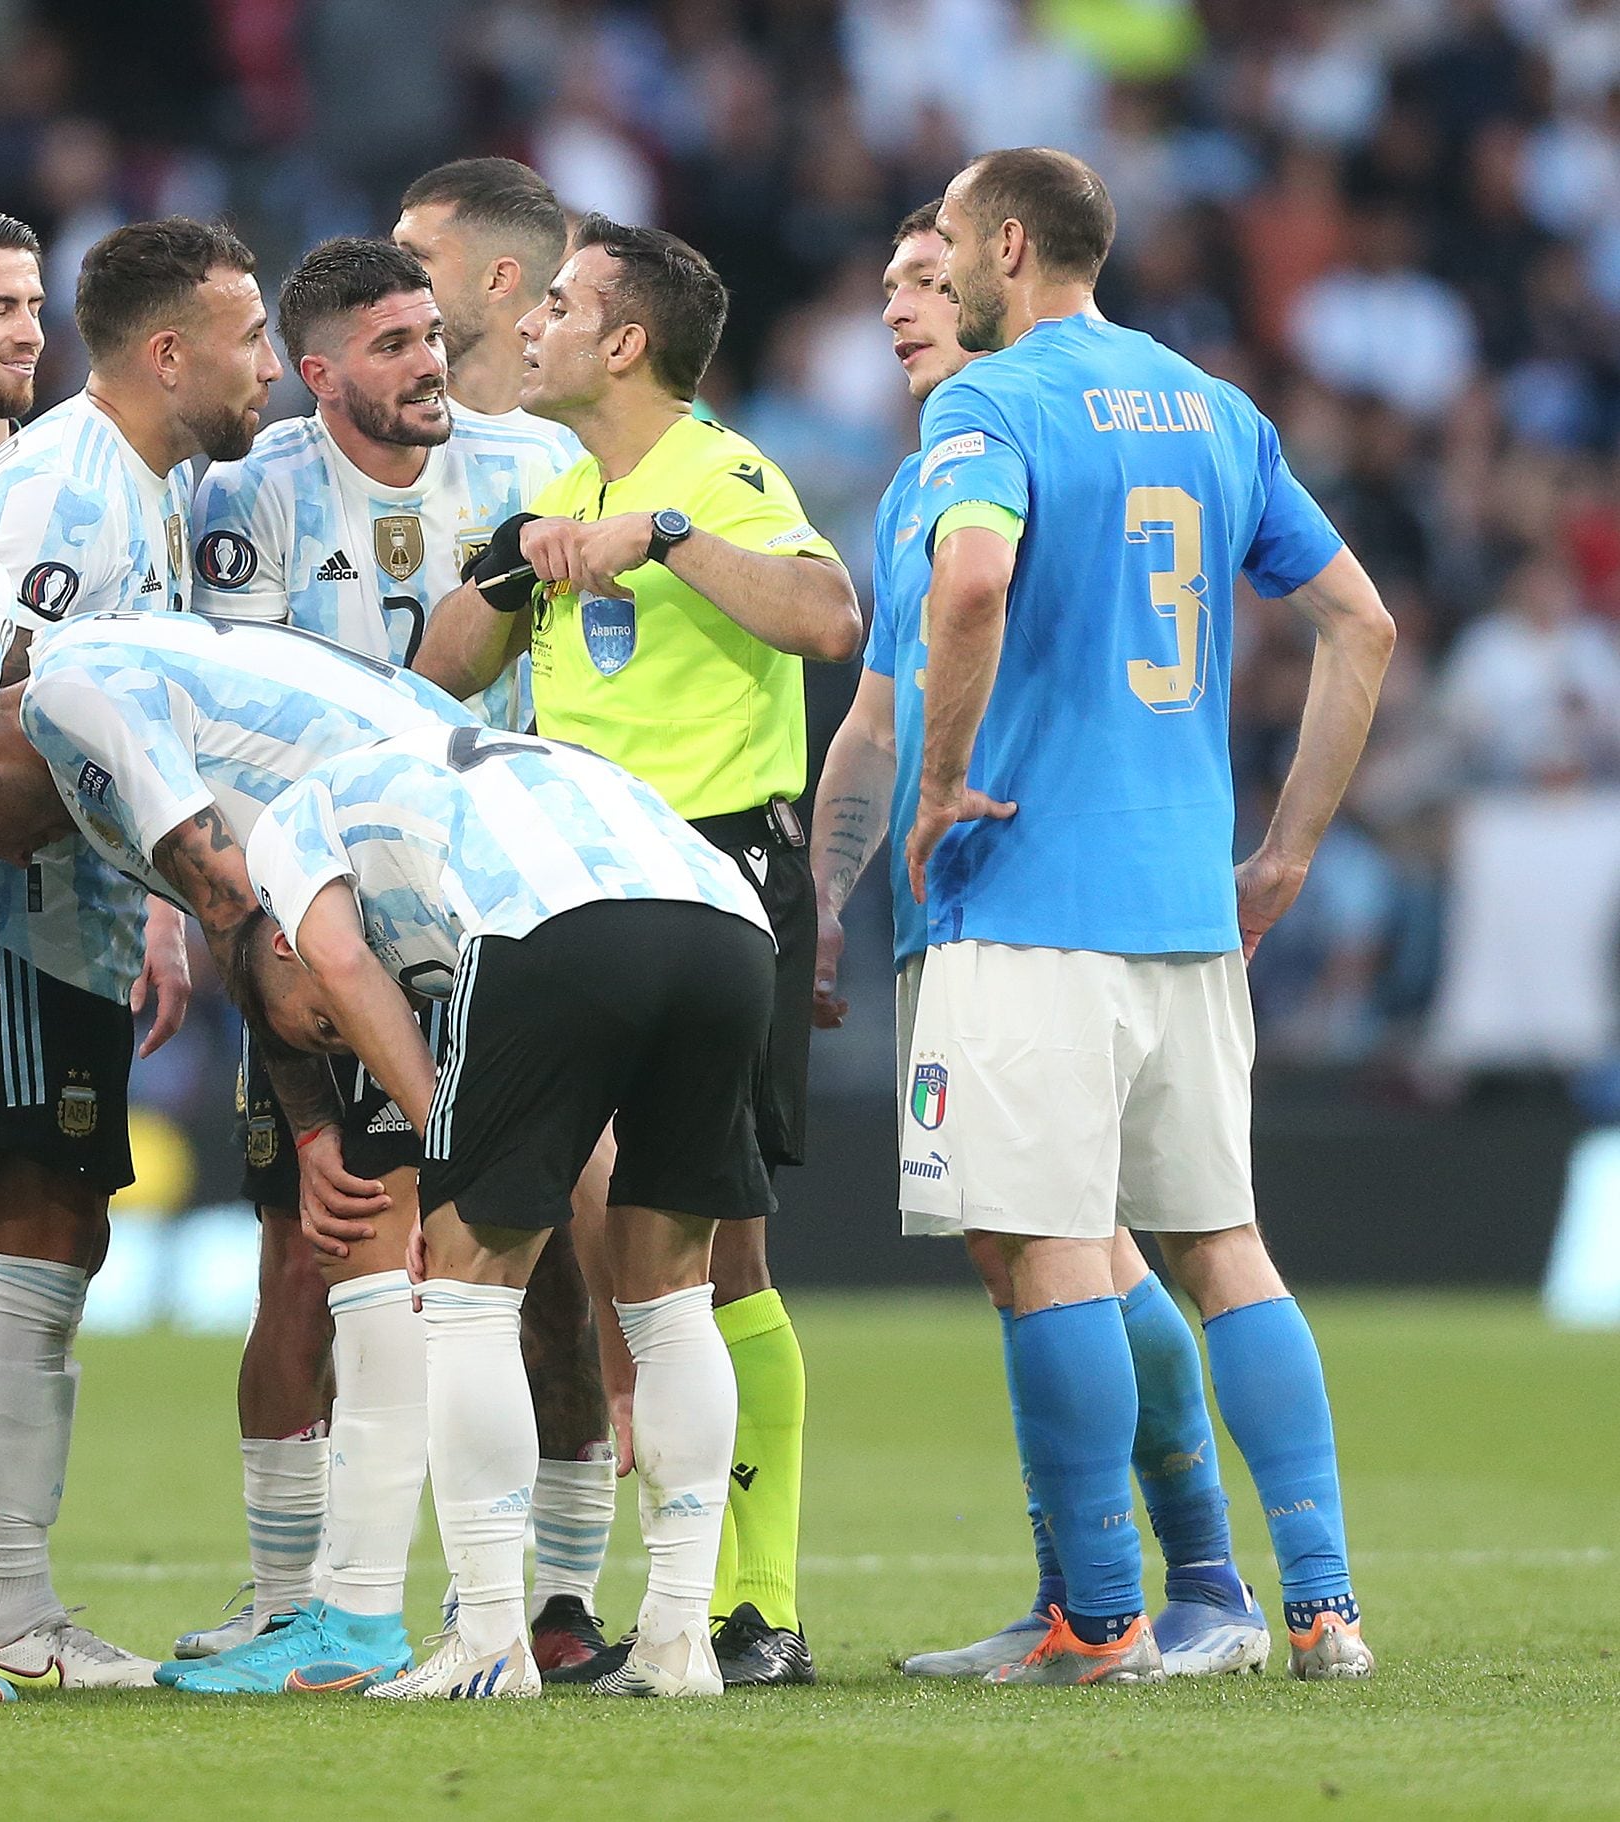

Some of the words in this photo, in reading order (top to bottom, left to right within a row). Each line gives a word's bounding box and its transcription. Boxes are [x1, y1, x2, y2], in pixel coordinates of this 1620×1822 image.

[1082, 388, 1215, 434] CHIELLINI
[317, 568, 359, 582] adidas
[1124, 486, 1210, 714] 3
[590, 625, 631, 638] ÁRBITRO
[600, 660, 619, 669] 2022
[917, 1066, 948, 1081] ITALIA
[367, 1118, 413, 1135] adidas
[902, 1159, 943, 1181] PUMA
